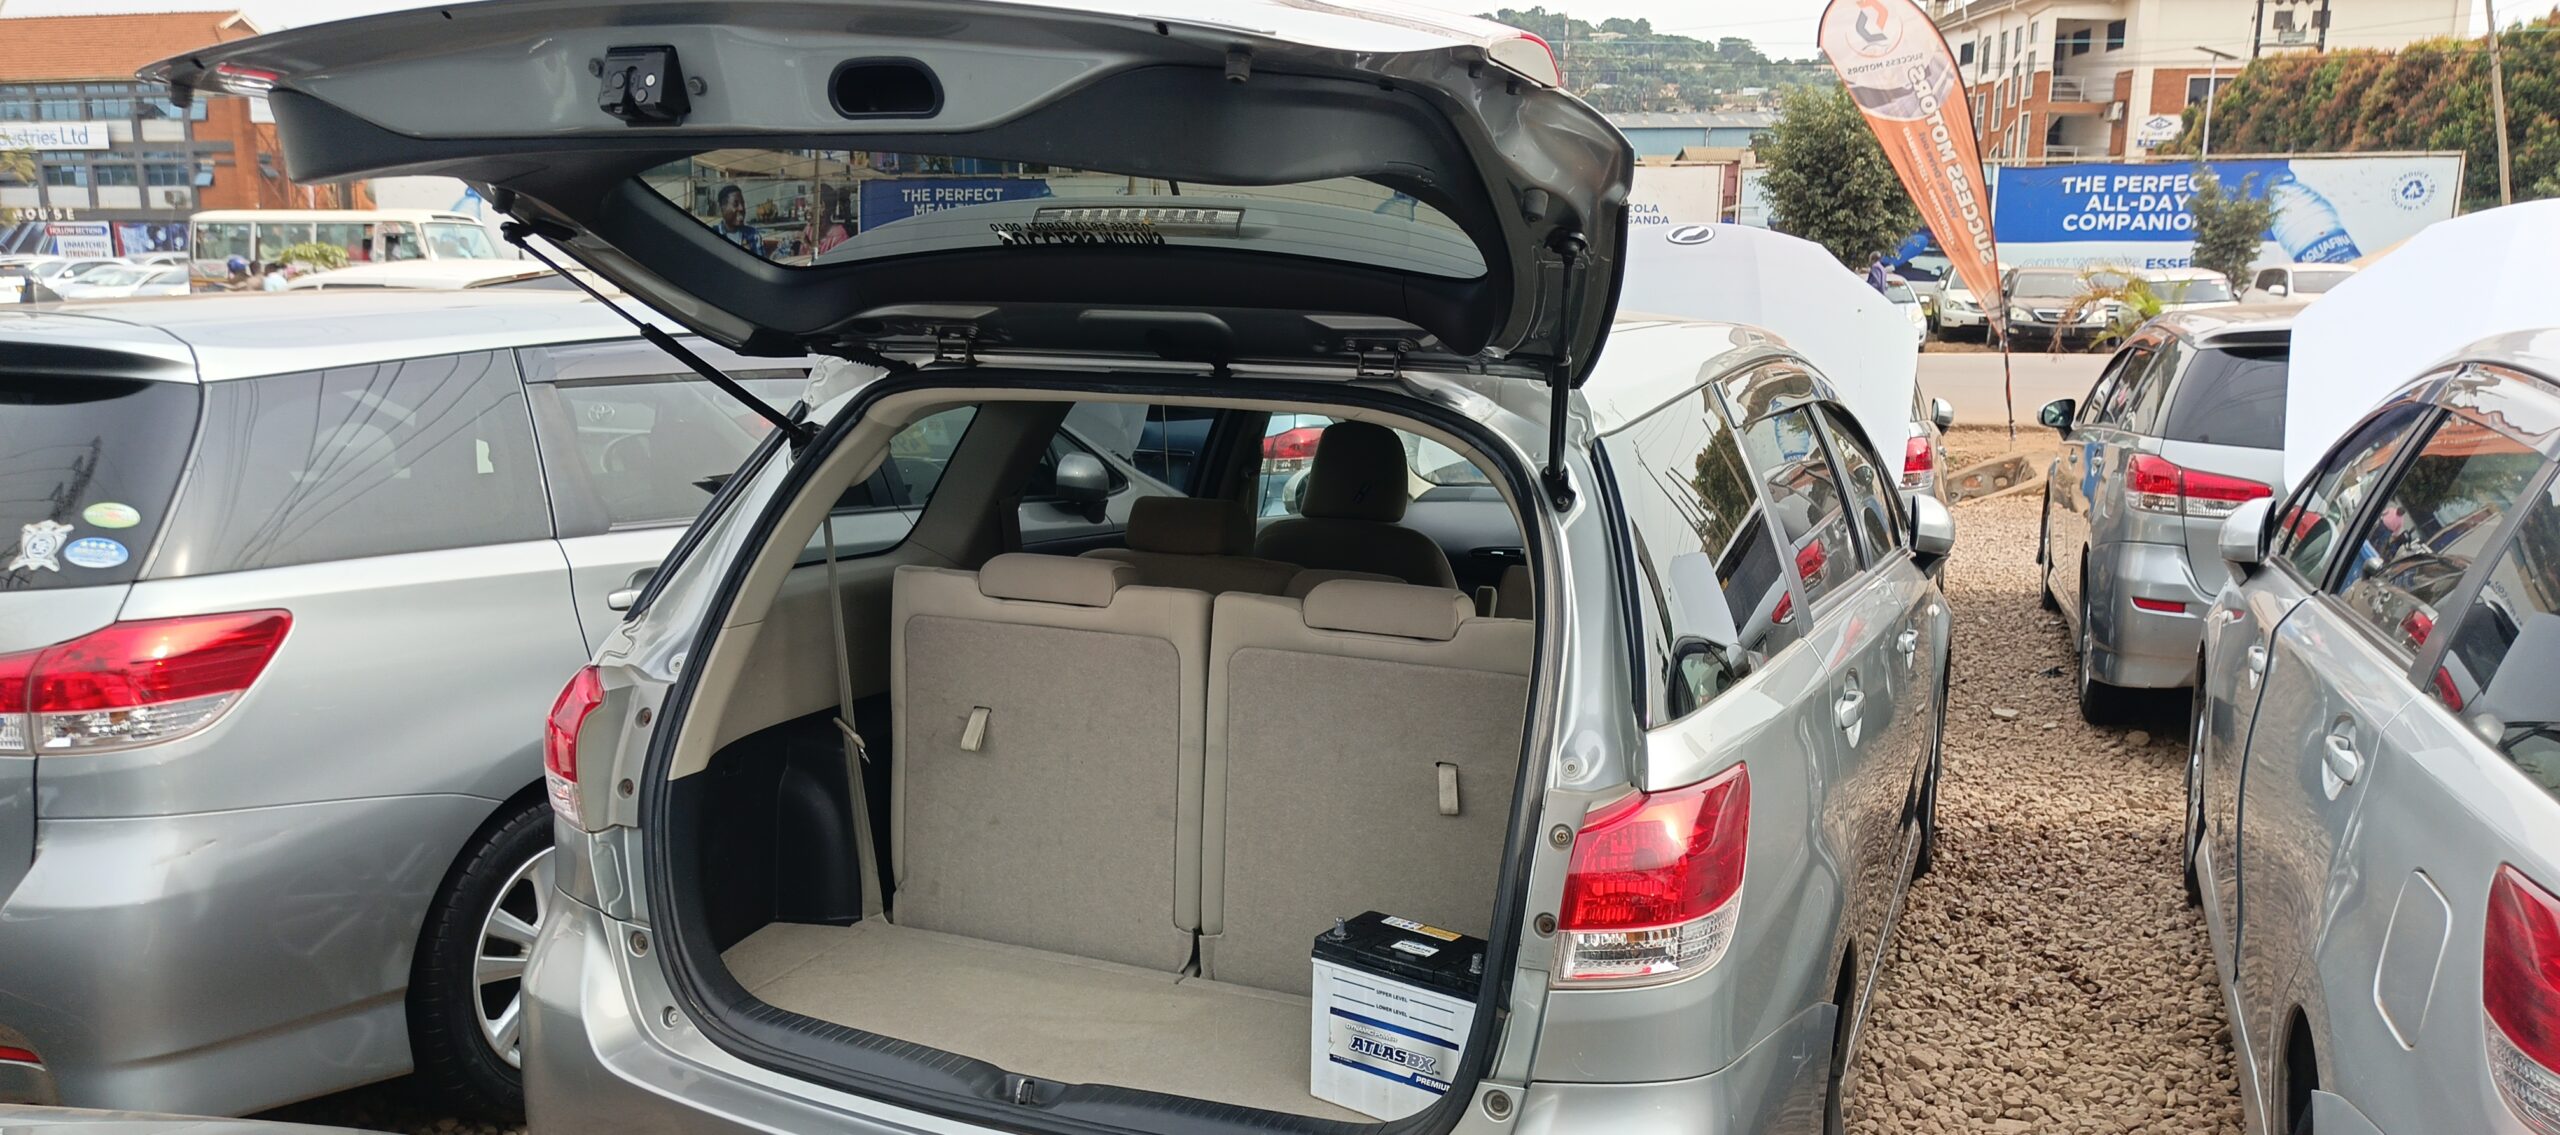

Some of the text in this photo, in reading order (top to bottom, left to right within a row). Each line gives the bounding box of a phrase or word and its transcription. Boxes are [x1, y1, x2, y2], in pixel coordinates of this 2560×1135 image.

[60, 125, 88, 145] Ltd
[2062, 176, 2106, 193] THE
[902, 187, 1003, 202] THE PERFECT
[2085, 194, 2190, 212] ALL-DAY
[1376, 990, 1408, 1003] UPPER LEVEL
[1376, 1004, 1408, 1018] LOWER LEVEL
[1350, 1035, 1436, 1074] ATLASBX
